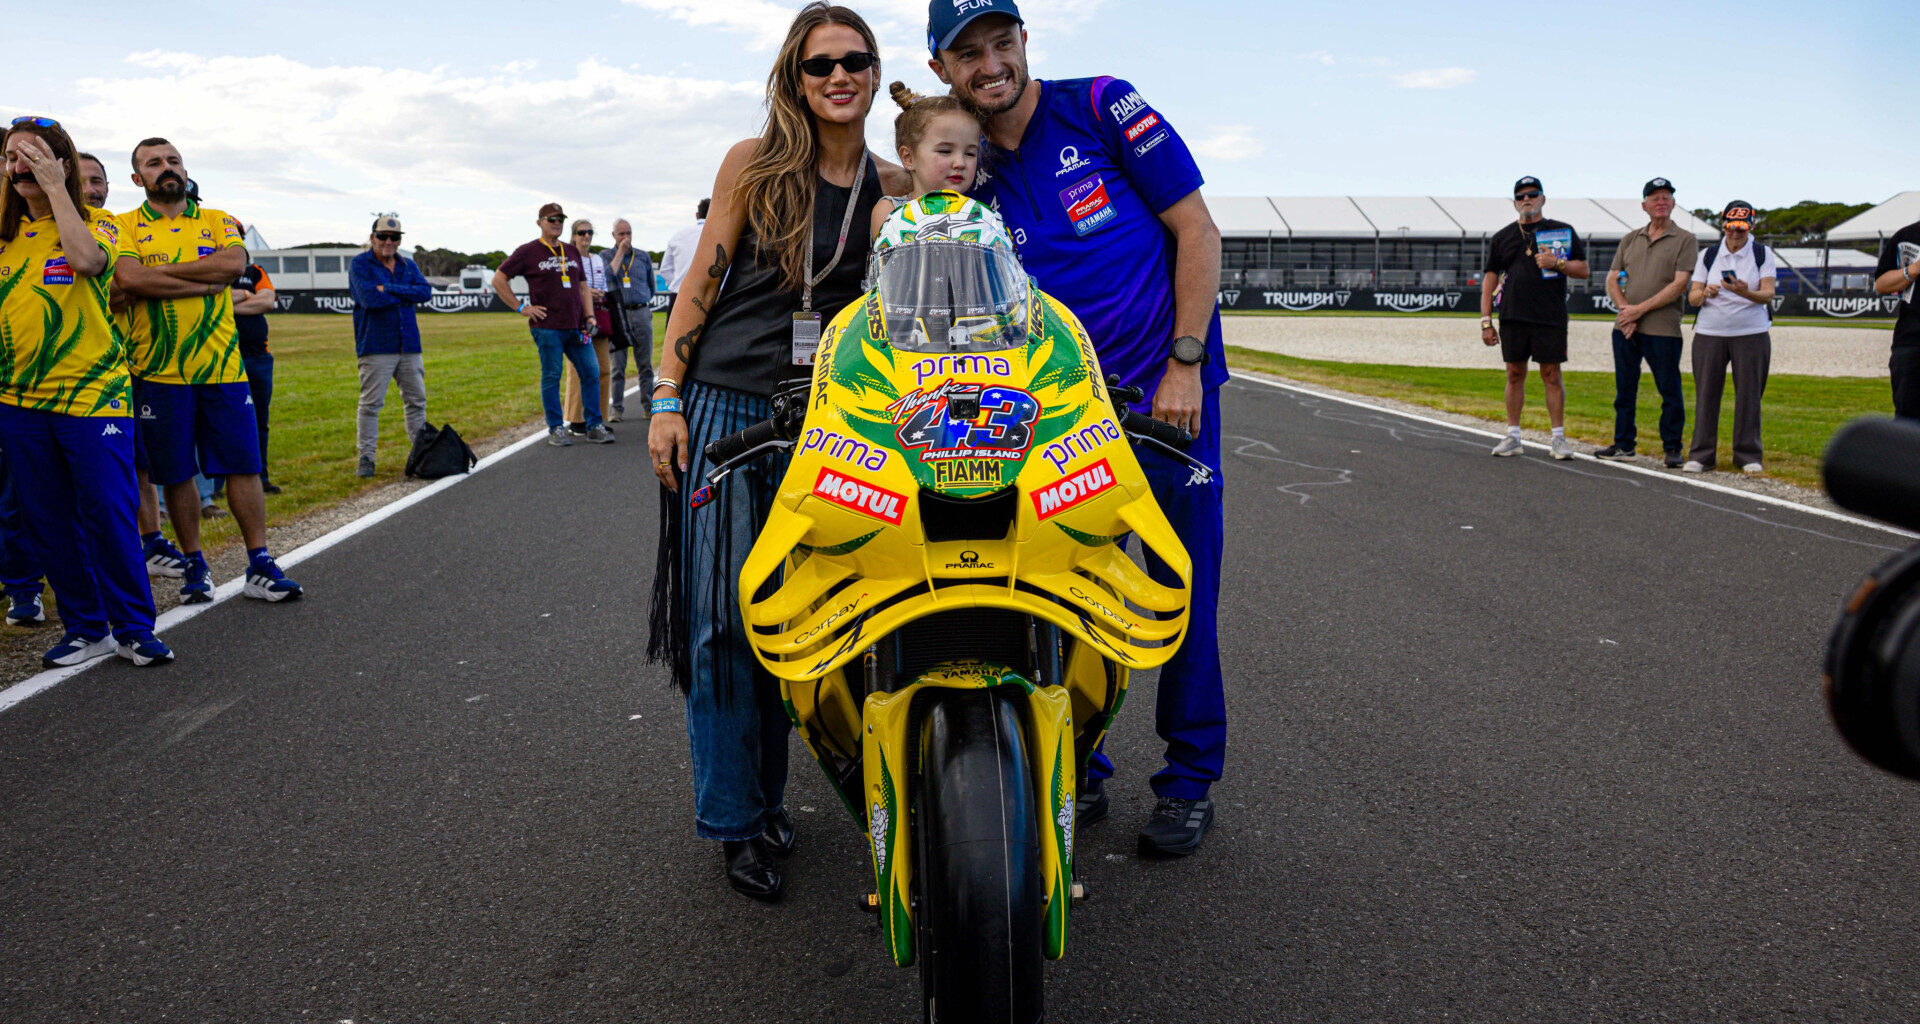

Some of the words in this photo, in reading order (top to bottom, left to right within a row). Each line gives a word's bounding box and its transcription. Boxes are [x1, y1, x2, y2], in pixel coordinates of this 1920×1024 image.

[1128, 115, 1157, 140] MOTUL
[1055, 158, 1091, 178] PRAMAC
[1068, 181, 1094, 200] prima
[1086, 206, 1113, 226] YAMAHA
[141, 253, 169, 264] rima
[314, 297, 354, 312] TRIUM
[1263, 292, 1334, 310] TRIUMPH
[1374, 293, 1445, 312] TRIUMPH
[1807, 297, 1880, 317] TRIUMPH
[867, 296, 885, 339] WRS
[815, 325, 837, 411] PRAMAC
[910, 355, 1011, 386] prima
[1073, 319, 1105, 403] PRAMAC
[897, 386, 1039, 450] 43
[798, 427, 888, 471] prima
[921, 450, 972, 461] PHILLIP
[974, 450, 1022, 460] ISLAND
[1042, 418, 1120, 474] prima
[936, 461, 1000, 482] FIAMM
[817, 474, 902, 519] MOTUL
[1040, 464, 1113, 515] MOTUL
[1068, 587, 1134, 629] Corpay
[793, 597, 861, 645] Corpay
[942, 669, 1000, 680] YAMAHA
